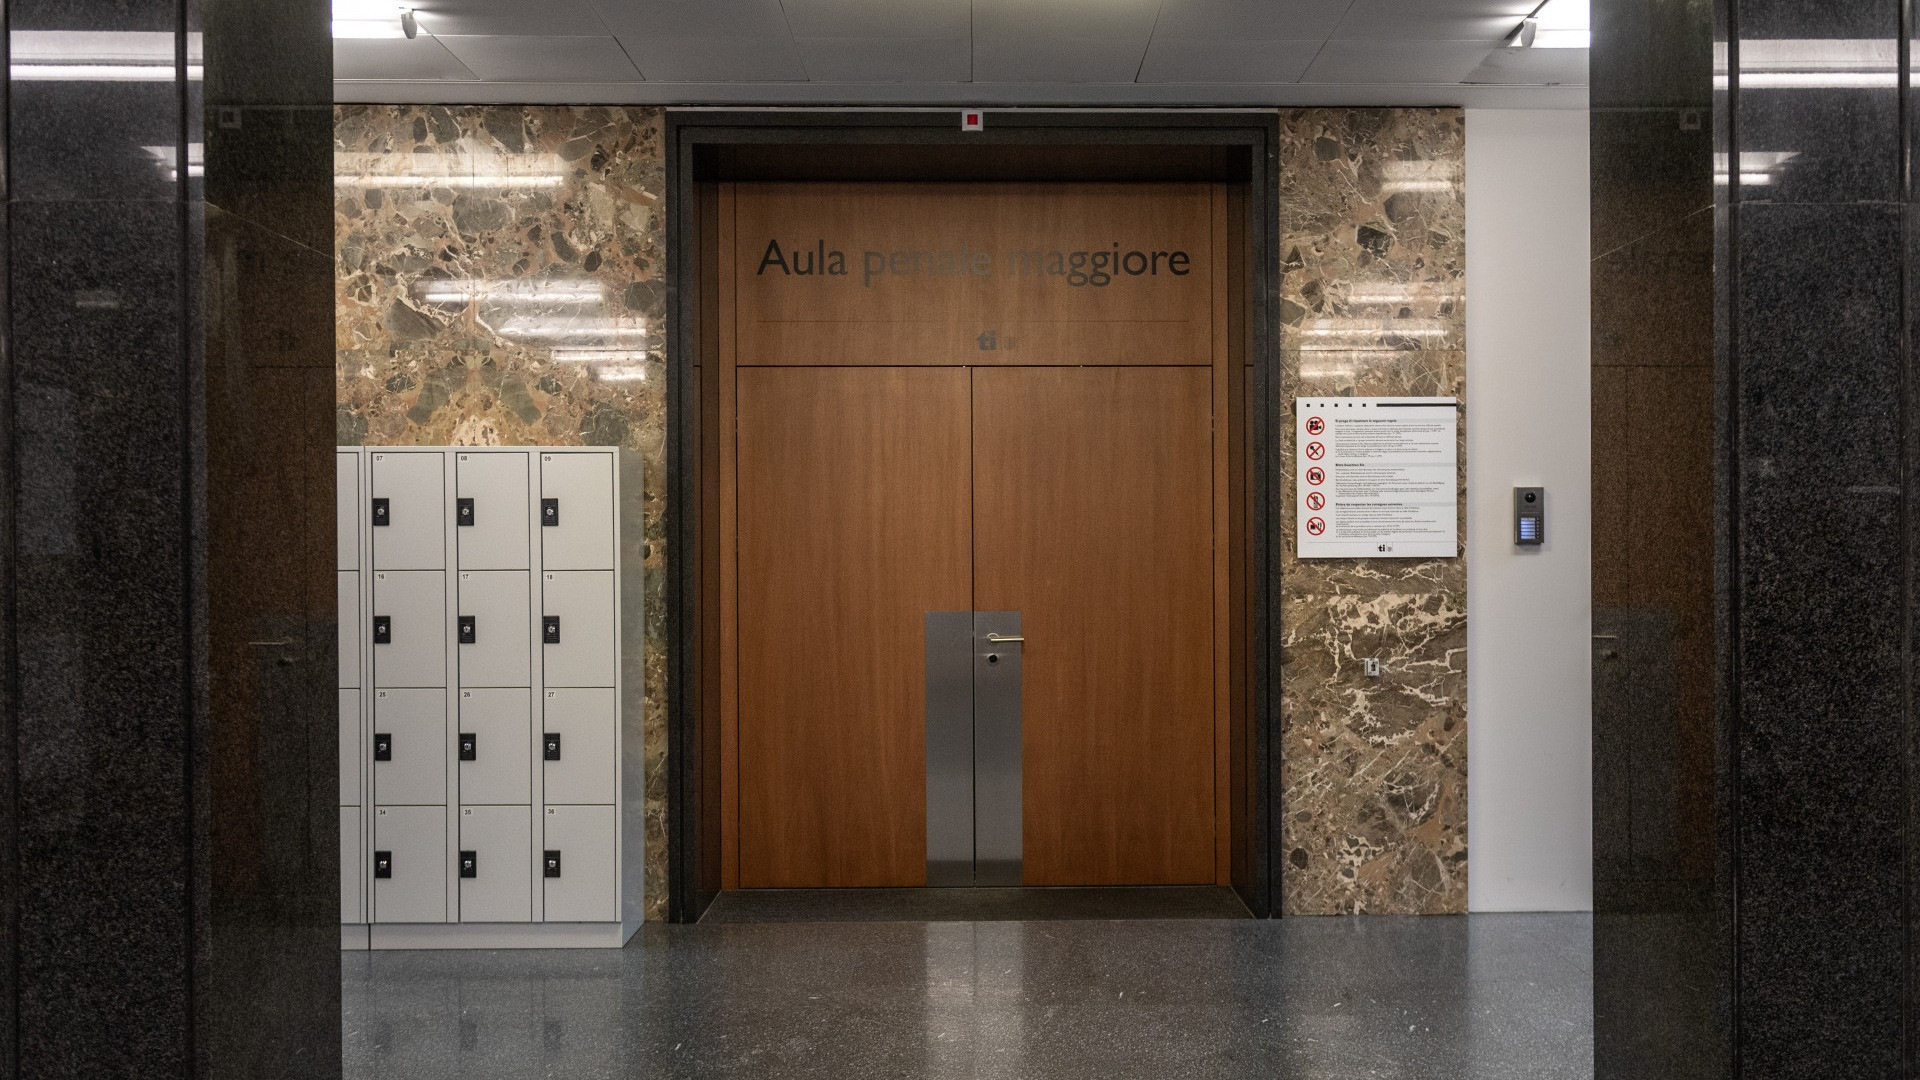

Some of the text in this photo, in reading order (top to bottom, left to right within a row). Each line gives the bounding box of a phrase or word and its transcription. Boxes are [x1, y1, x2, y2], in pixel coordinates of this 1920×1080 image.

[757, 239, 1191, 288] Aula penale maggiore
[1378, 544, 1386, 552] ti
